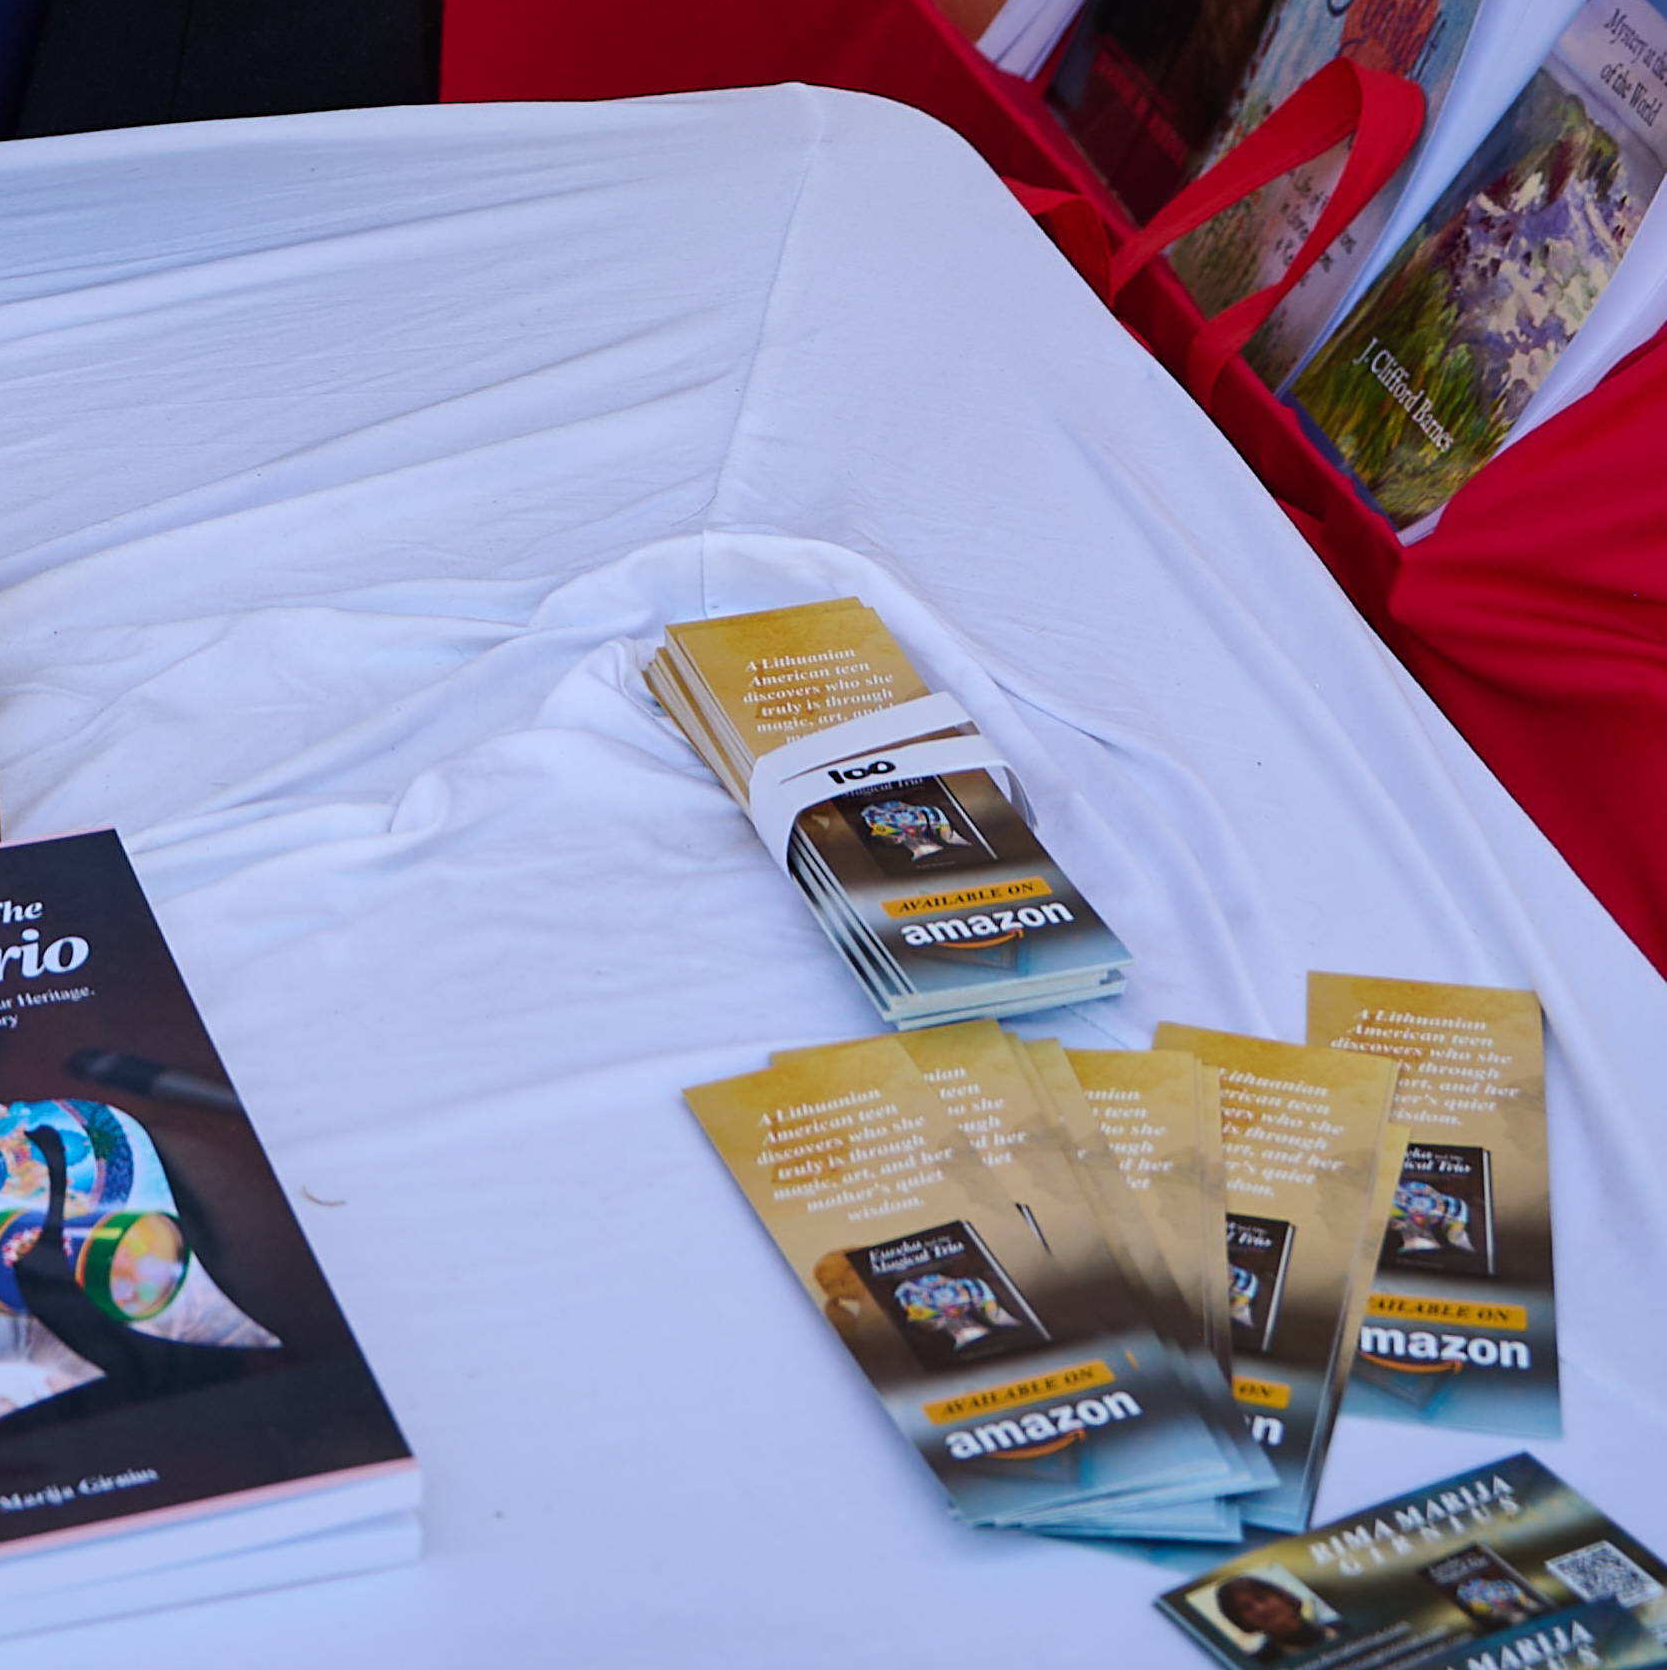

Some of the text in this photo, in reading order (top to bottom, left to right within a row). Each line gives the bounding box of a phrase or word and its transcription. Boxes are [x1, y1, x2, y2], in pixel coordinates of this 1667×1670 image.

[1603, 8, 1648, 64] Mystery
[1600, 63, 1663, 127] of the World
[1353, 336, 1455, 453] J. Clifford Barnes
[745, 648, 856, 672] A Lithuanian
[749, 662, 871, 687] American teen
[743, 673, 894, 704] discovers who she
[761, 688, 894, 718] truly is through
[828, 760, 896, 785] 100
[899, 881, 1035, 913] AVAILABLE ON
[900, 901, 1075, 946] amazon
[1476, 1306, 1511, 1323] ON
[1359, 1325, 1531, 1370] mazon
[942, 1366, 1095, 1415] AVAILABLE ON
[945, 1391, 1143, 1460] amazon
[1309, 1474, 1516, 1566] RIMA MARIJA
